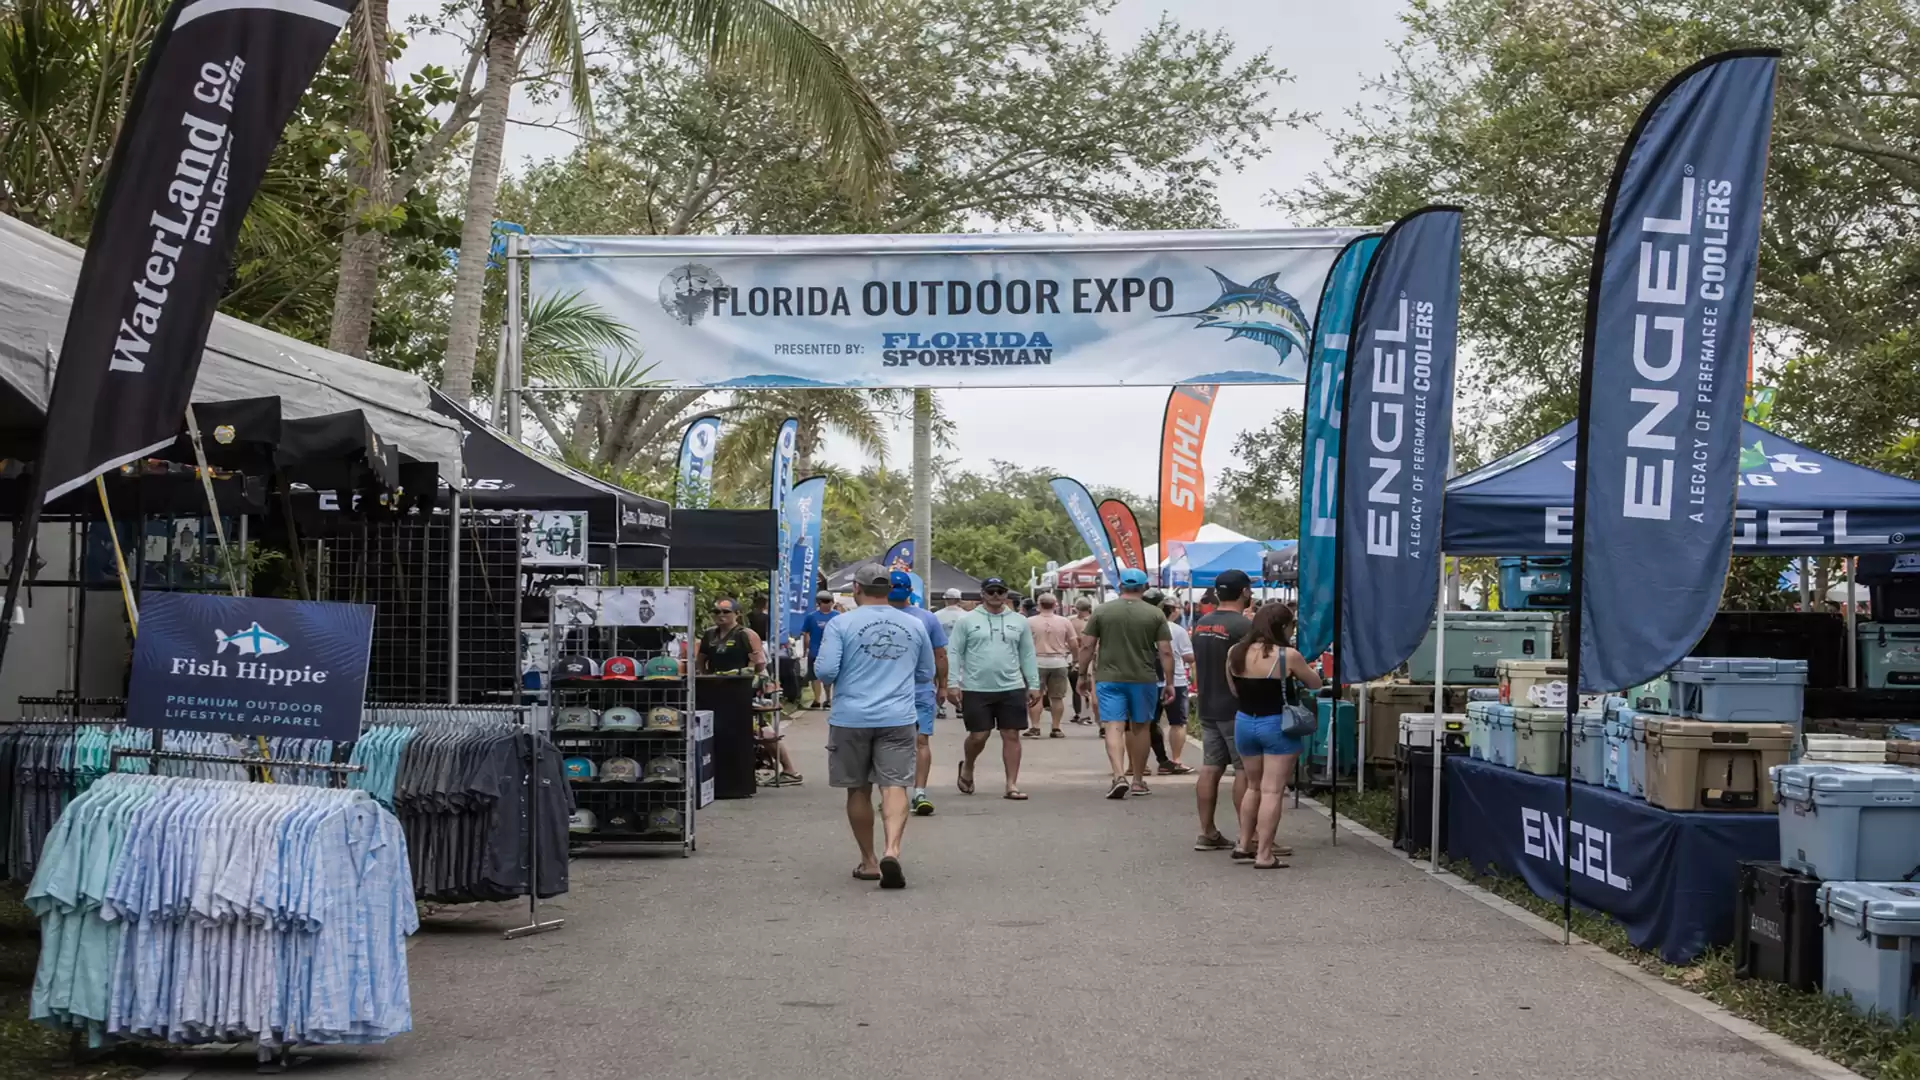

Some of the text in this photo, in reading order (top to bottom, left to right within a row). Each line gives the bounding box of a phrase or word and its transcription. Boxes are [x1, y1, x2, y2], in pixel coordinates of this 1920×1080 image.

[108, 111, 227, 374] WaterLand
[1701, 178, 1732, 301] COOLERS
[712, 276, 1175, 317] FLORIDA OUTDOOR EXPO
[774, 343, 865, 356] PRESENTED BY:
[882, 331, 1053, 349] FLORIDA
[1413, 300, 1434, 393] COOLERS
[1623, 176, 1695, 521] ENGEL
[882, 348, 1053, 368] SPORTSMAN
[1366, 298, 1408, 558] ENGEL
[1696, 409, 1711, 432] OF
[1170, 414, 1202, 513] STIHL
[1690, 440, 1709, 505] LEGACY
[1413, 474, 1425, 492] OF
[1410, 496, 1424, 546] LEGACY
[1688, 512, 1704, 523] A
[1409, 549, 1420, 559] A
[170, 657, 328, 687] Fish Hippie
[165, 708, 321, 728] LIFESTYLE APPAREL
[166, 695, 323, 714] PREMIUM OUTDOOR
